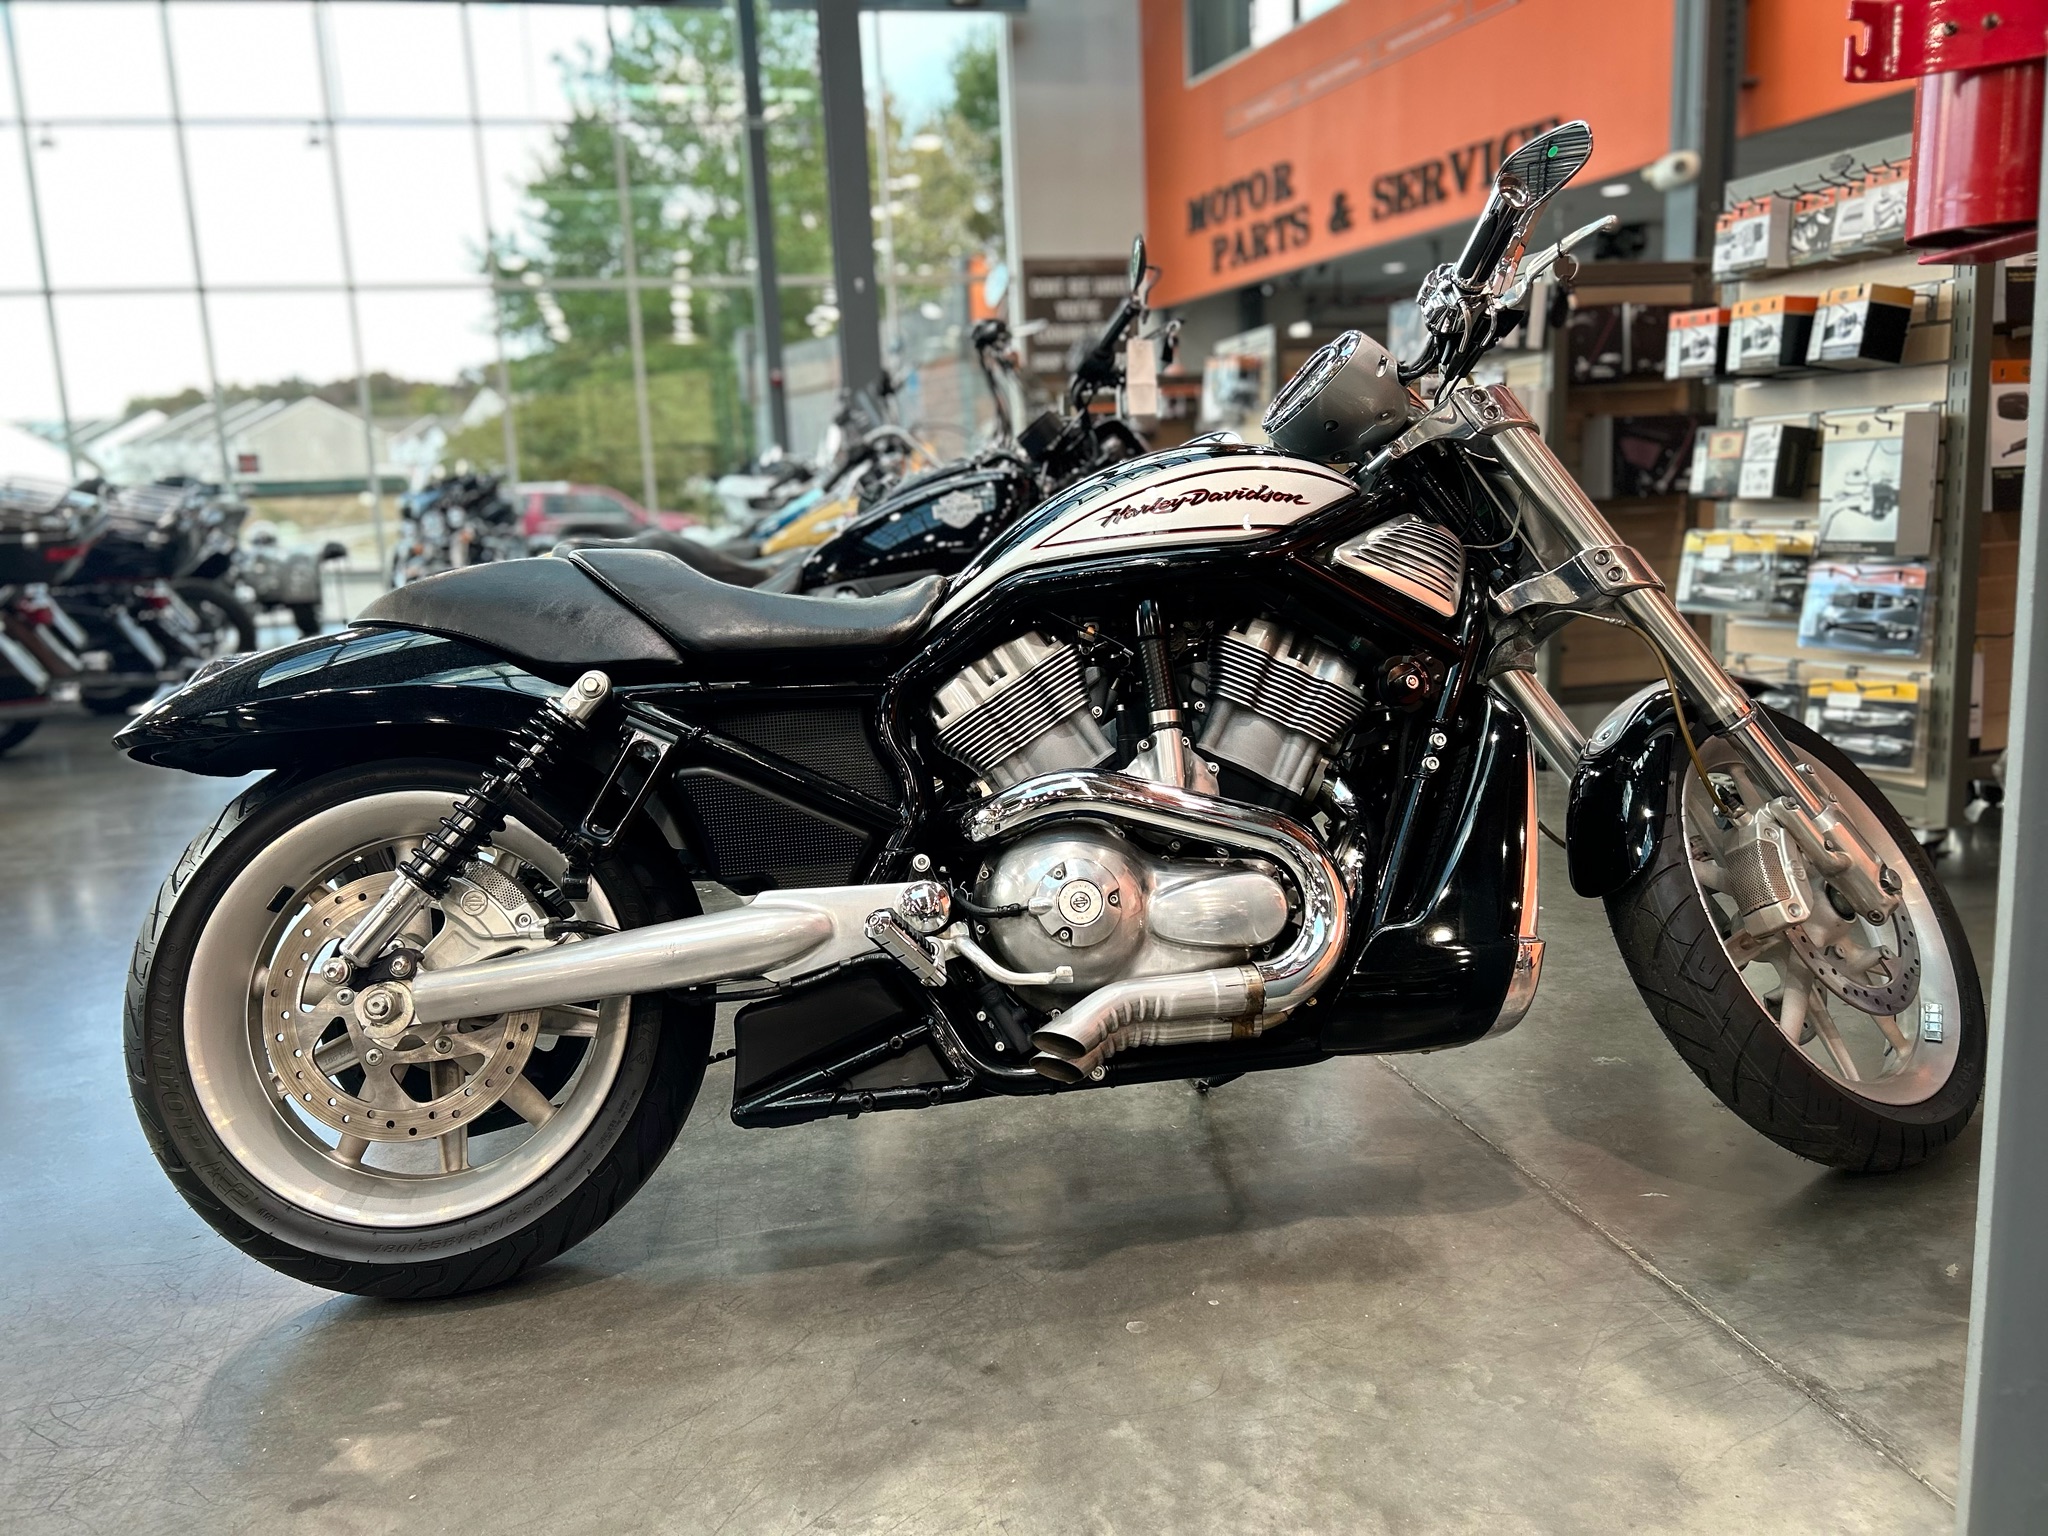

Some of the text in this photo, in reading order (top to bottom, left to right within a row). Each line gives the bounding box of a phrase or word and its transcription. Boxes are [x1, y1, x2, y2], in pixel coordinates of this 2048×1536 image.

[1188, 163, 1294, 233] MOTOR
[1212, 117, 1561, 273] PARTS & SERVIC
[1096, 485, 1311, 528] Harley-Davidson
